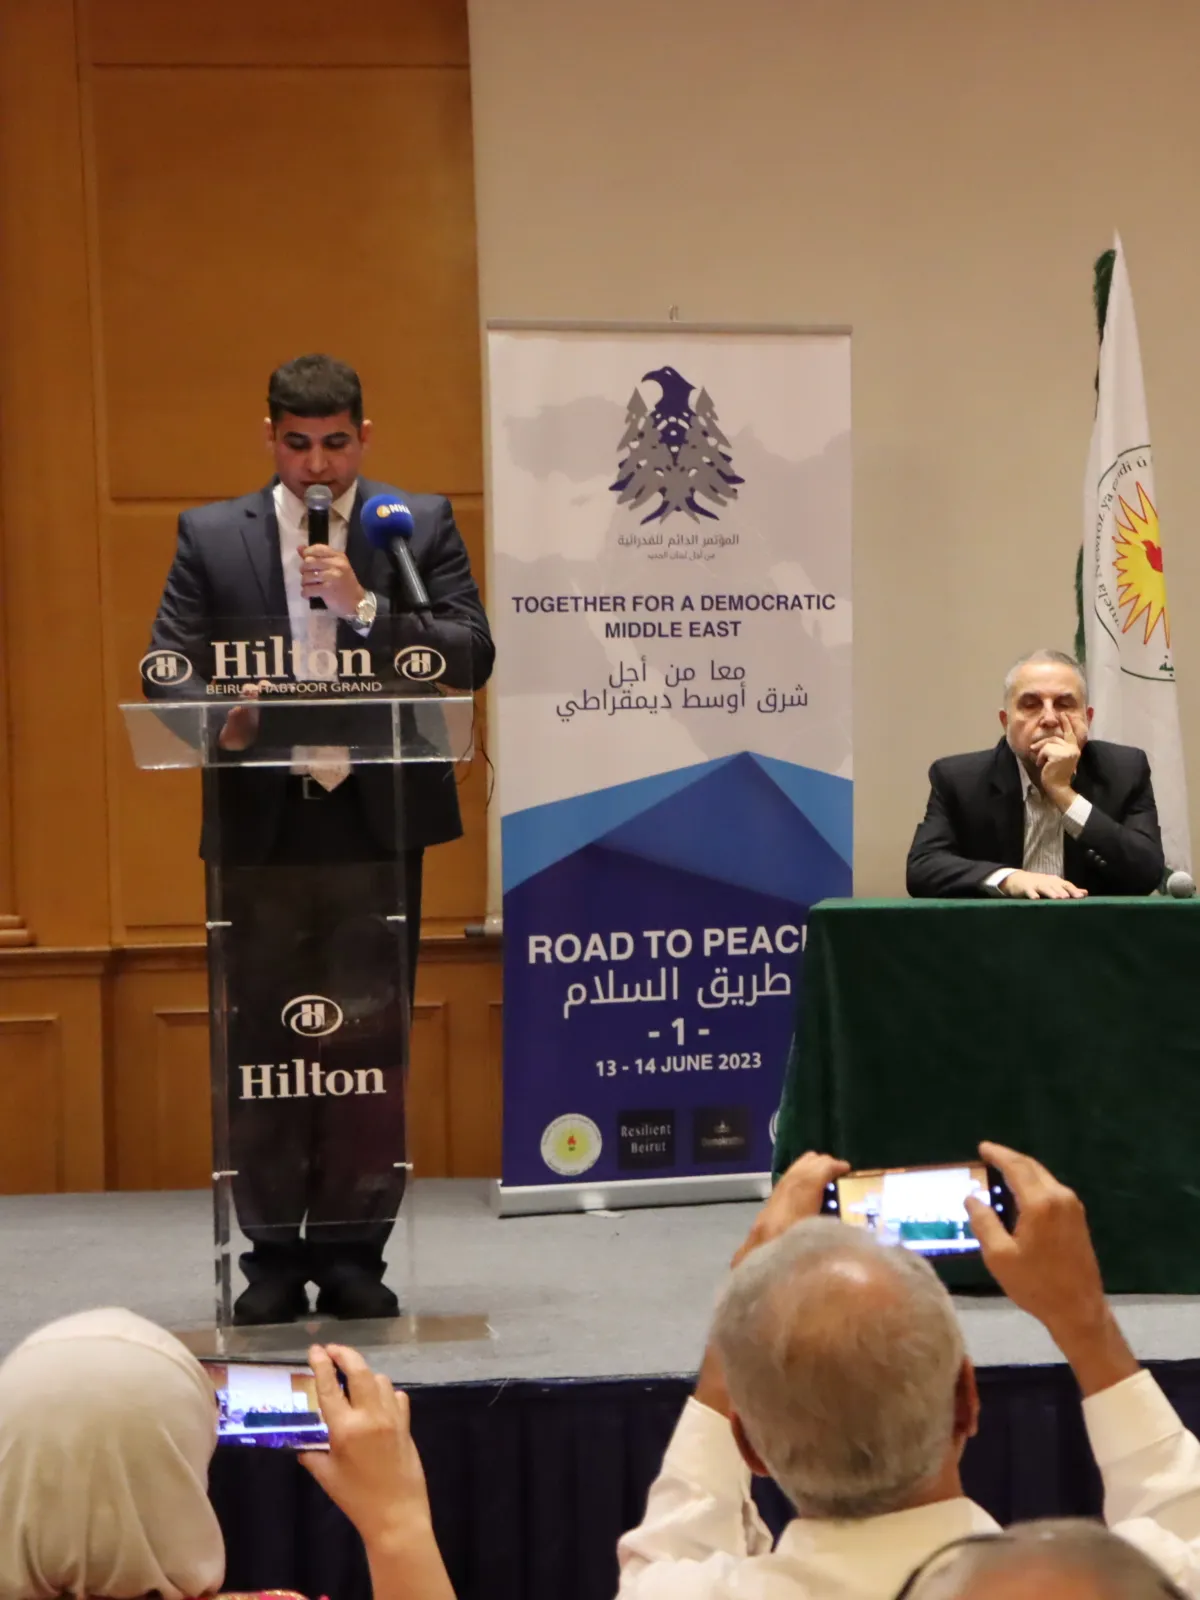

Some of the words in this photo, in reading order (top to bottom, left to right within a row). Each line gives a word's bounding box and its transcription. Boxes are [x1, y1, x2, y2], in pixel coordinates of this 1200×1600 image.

[668, 533, 699, 548] الدائم
[702, 533, 739, 548] المؤتمر
[512, 596, 625, 613] TOGETHER
[632, 595, 674, 612] FOR
[681, 595, 695, 611] A
[701, 594, 836, 611] DEMOCRATIC
[605, 622, 682, 638] MIDDLE
[689, 621, 741, 637] EAST
[210, 636, 375, 681] Hilton
[711, 660, 745, 680] معا
[609, 655, 646, 688] أجل
[665, 664, 695, 687] من
[206, 683, 249, 695] BEIRU
[259, 682, 327, 695] HABTOOR
[331, 681, 382, 693] GRAND
[682, 681, 746, 714] أوسط
[757, 684, 808, 713] شرق
[556, 688, 672, 722] ديمقراطي
[528, 931, 634, 964] ROAD
[643, 929, 693, 959] TO
[563, 966, 679, 1019] السلام
[697, 962, 791, 1008] طريق
[596, 1060, 617, 1077] 13
[634, 1058, 656, 1074] 14
[661, 1054, 713, 1073] JUNE
[718, 1052, 762, 1070] 2023
[238, 1059, 387, 1100] Hilton
[620, 1123, 671, 1138] Resilient
[630, 1141, 666, 1154] Beirut
